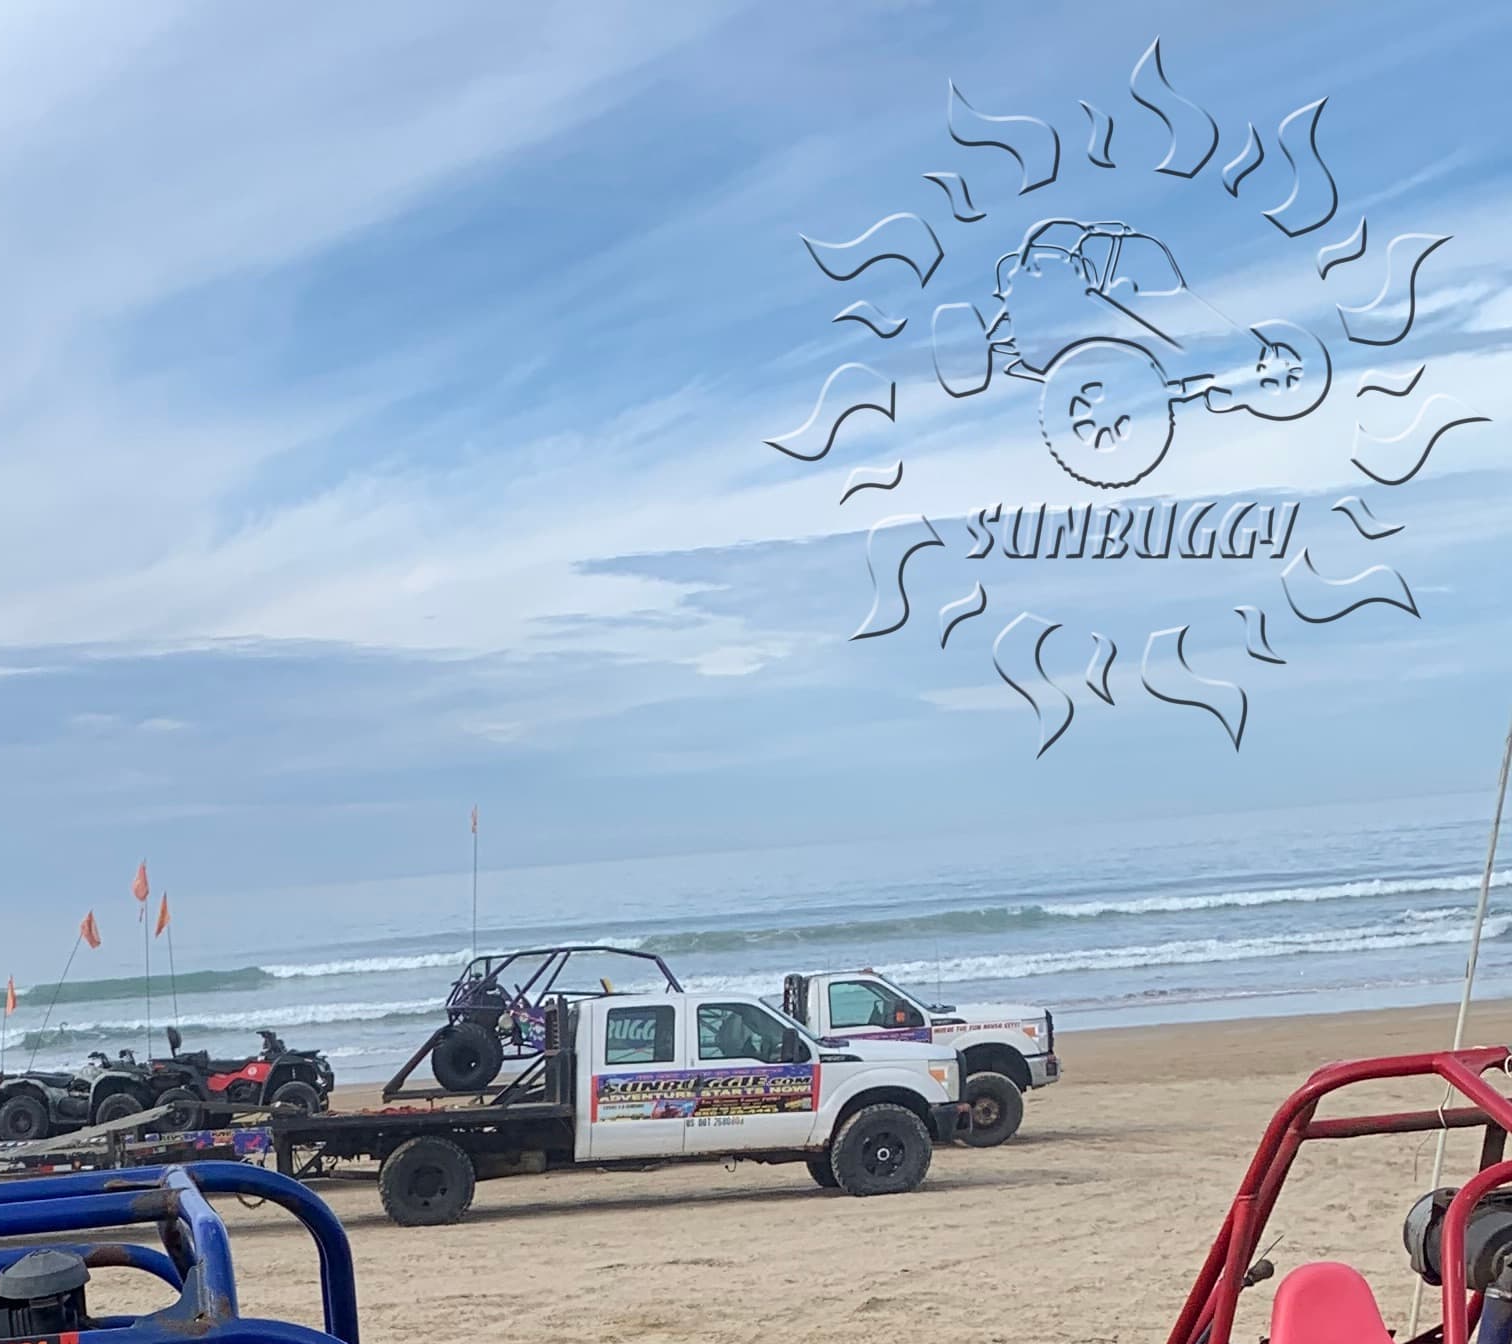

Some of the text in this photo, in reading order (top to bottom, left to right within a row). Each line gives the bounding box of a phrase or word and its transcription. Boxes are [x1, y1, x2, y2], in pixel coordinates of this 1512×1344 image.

[599, 1090, 697, 1103] ADVENTURE
[701, 1086, 765, 1097] STARTS
[769, 1083, 812, 1094] NOW!
